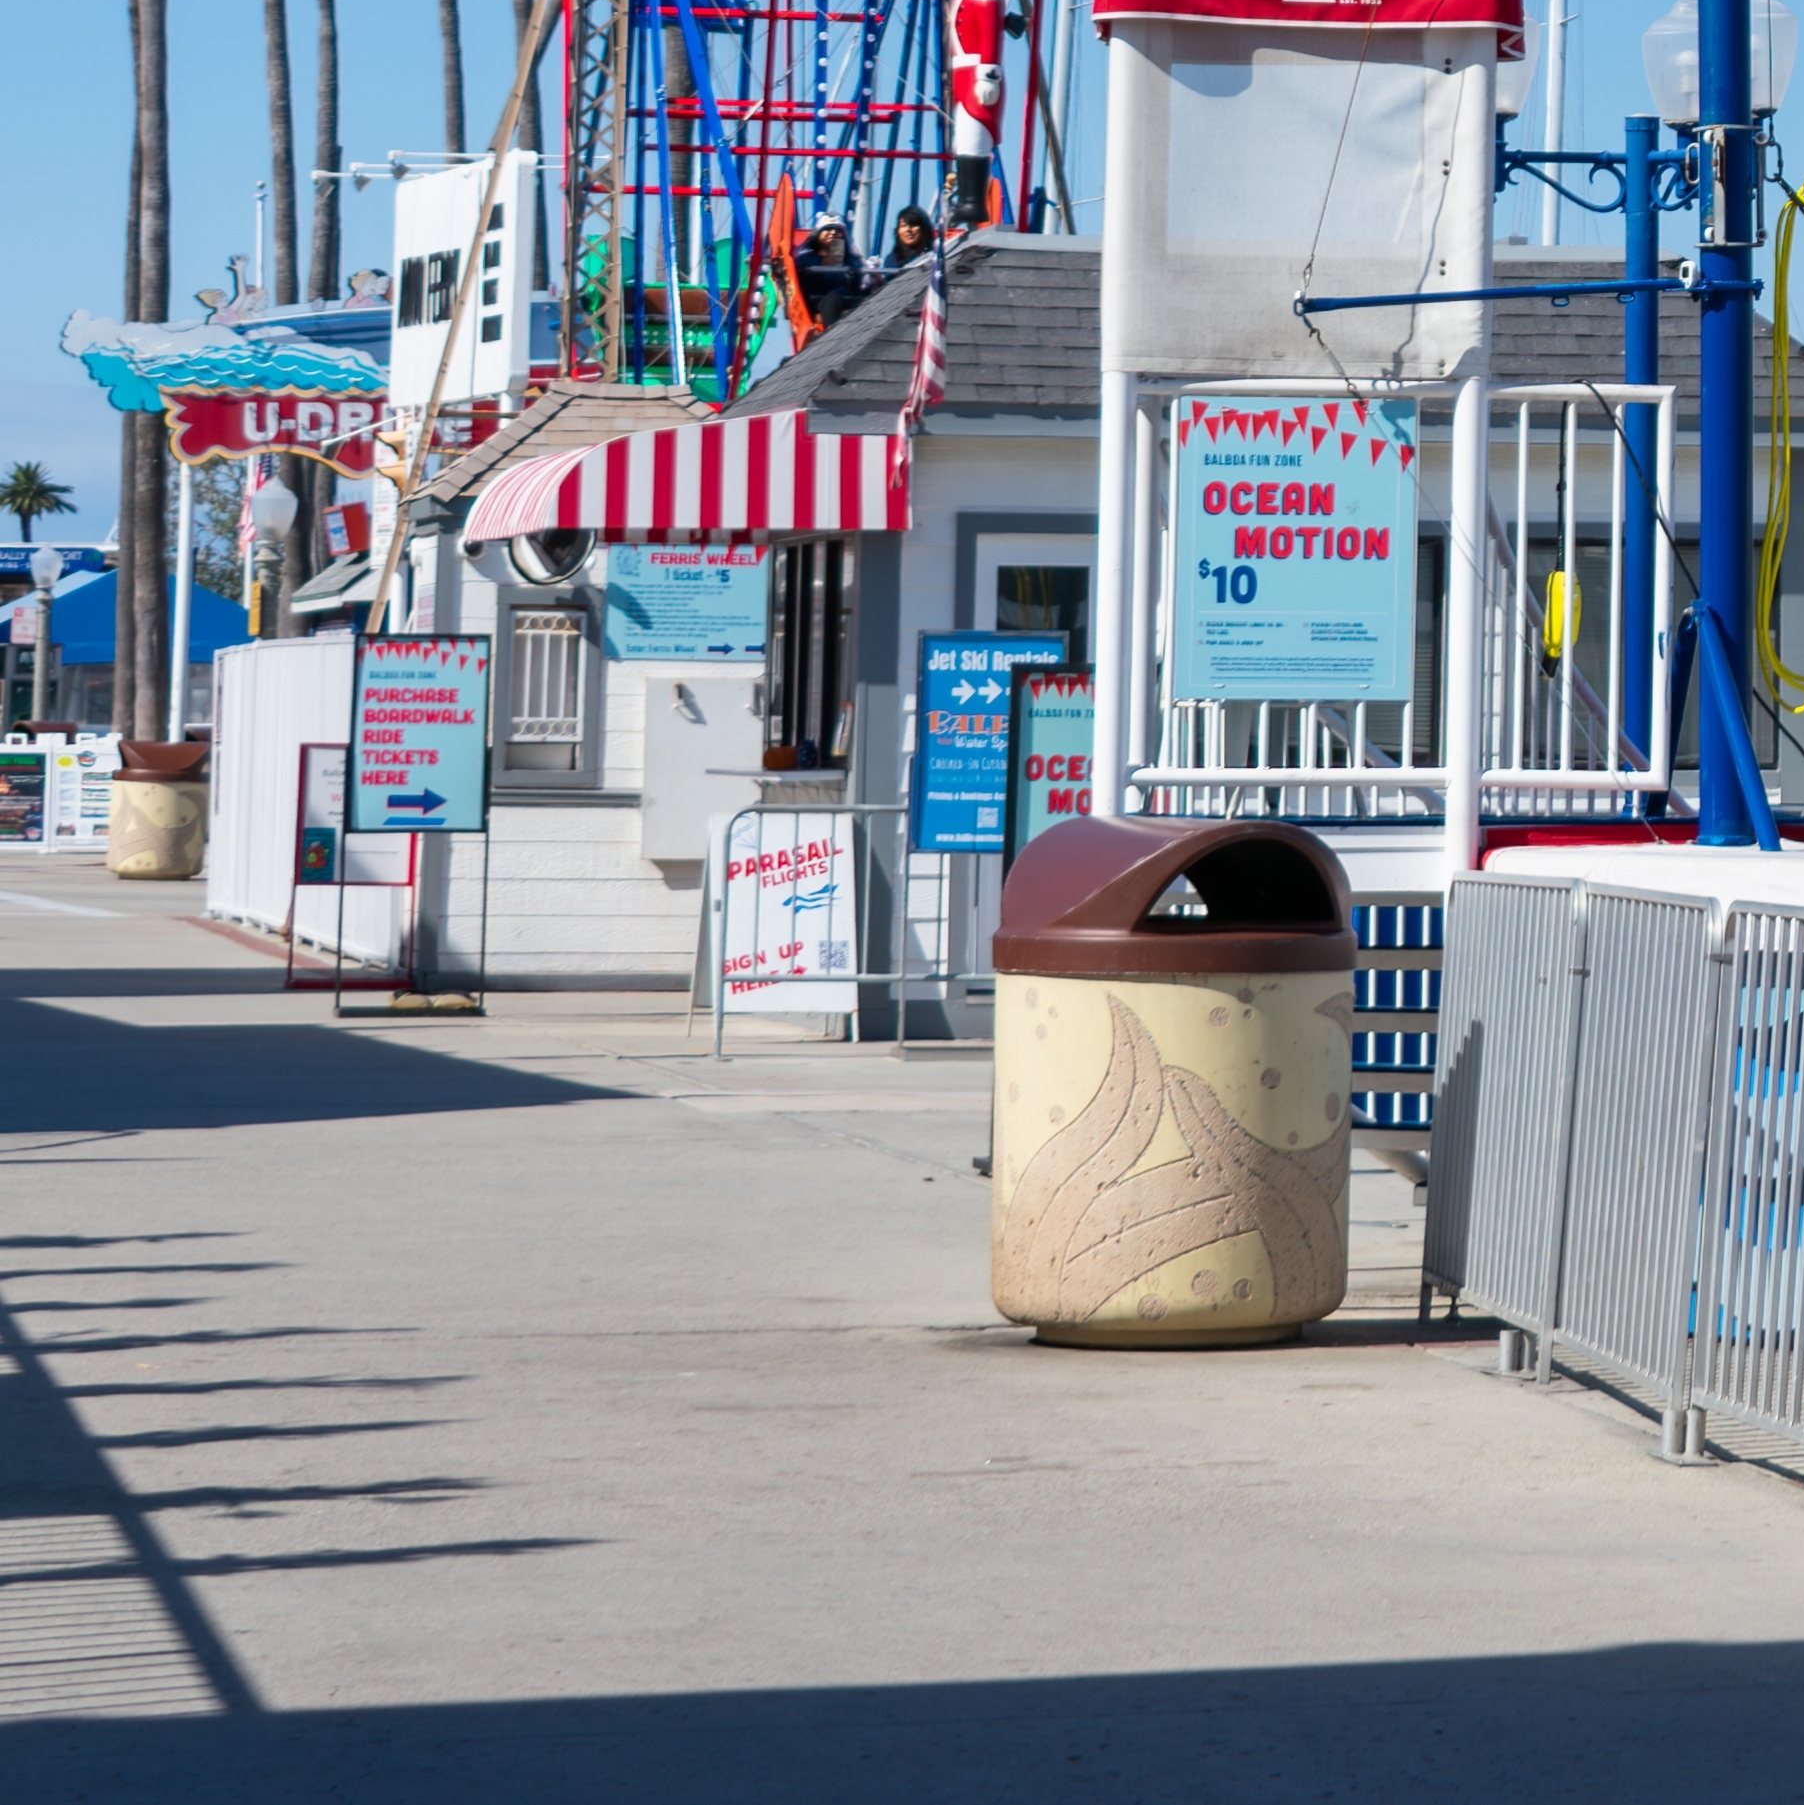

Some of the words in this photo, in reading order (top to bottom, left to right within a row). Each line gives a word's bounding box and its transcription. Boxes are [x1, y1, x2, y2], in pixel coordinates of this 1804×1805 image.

[242, 401, 473, 443] U-DRIE
[1204, 453, 1246, 466] BALBOA
[1250, 454, 1271, 466] FUN
[1274, 454, 1303, 467] ZONE
[1203, 481, 1335, 515] OCEAN
[1234, 525, 1390, 560] MOTION
[650, 552, 701, 565] FERRIS
[706, 553, 758, 566] WHEEL
[673, 568, 704, 581] ticket
[1199, 558, 1257, 604] $10
[928, 650, 956, 671] Jet
[960, 650, 988, 671] Ski
[401, 670, 415, 679] FUN
[418, 670, 438, 679] ZONE
[363, 687, 460, 704] PURCHASE
[363, 708, 476, 724] BOARDWALK
[1028, 708, 1063, 719] BALBOA
[1065, 708, 1081, 718] FUN
[362, 729, 405, 744] RIDE
[954, 735, 989, 748] Water
[362, 749, 440, 765] TICKETS
[1025, 754, 1094, 781] OCE
[360, 770, 409, 786] HERE
[727, 837, 844, 882] PARASAIL
[761, 860, 829, 888] FLIGHTS
[723, 950, 767, 976] SIGN
[778, 941, 804, 959] UP
